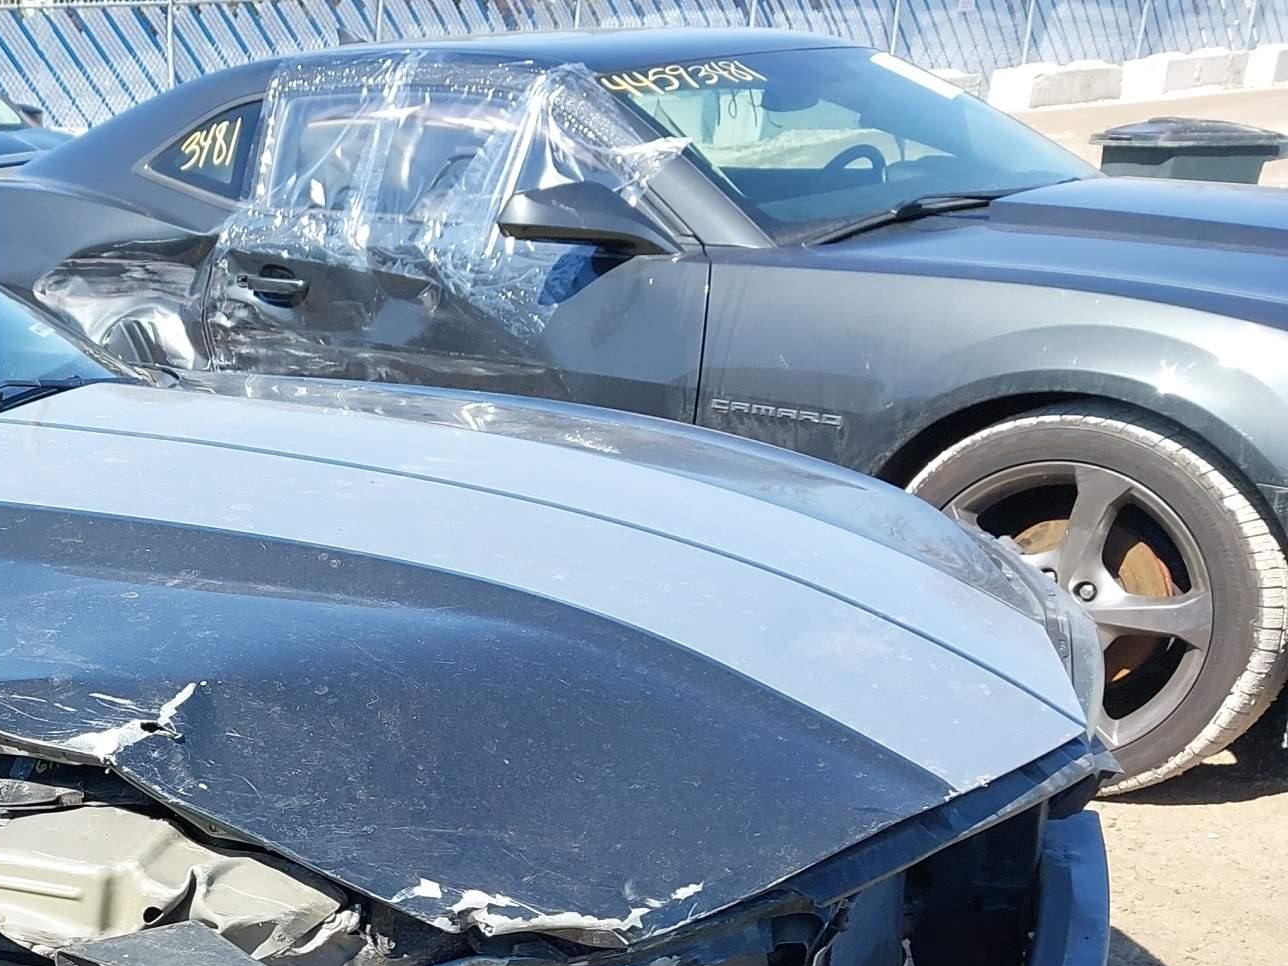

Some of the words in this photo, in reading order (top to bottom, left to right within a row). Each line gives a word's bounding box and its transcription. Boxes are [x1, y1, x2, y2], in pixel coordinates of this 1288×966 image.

[600, 59, 768, 98] 44593481
[180, 116, 243, 171] 3481
[711, 398, 843, 427] CAMARO
